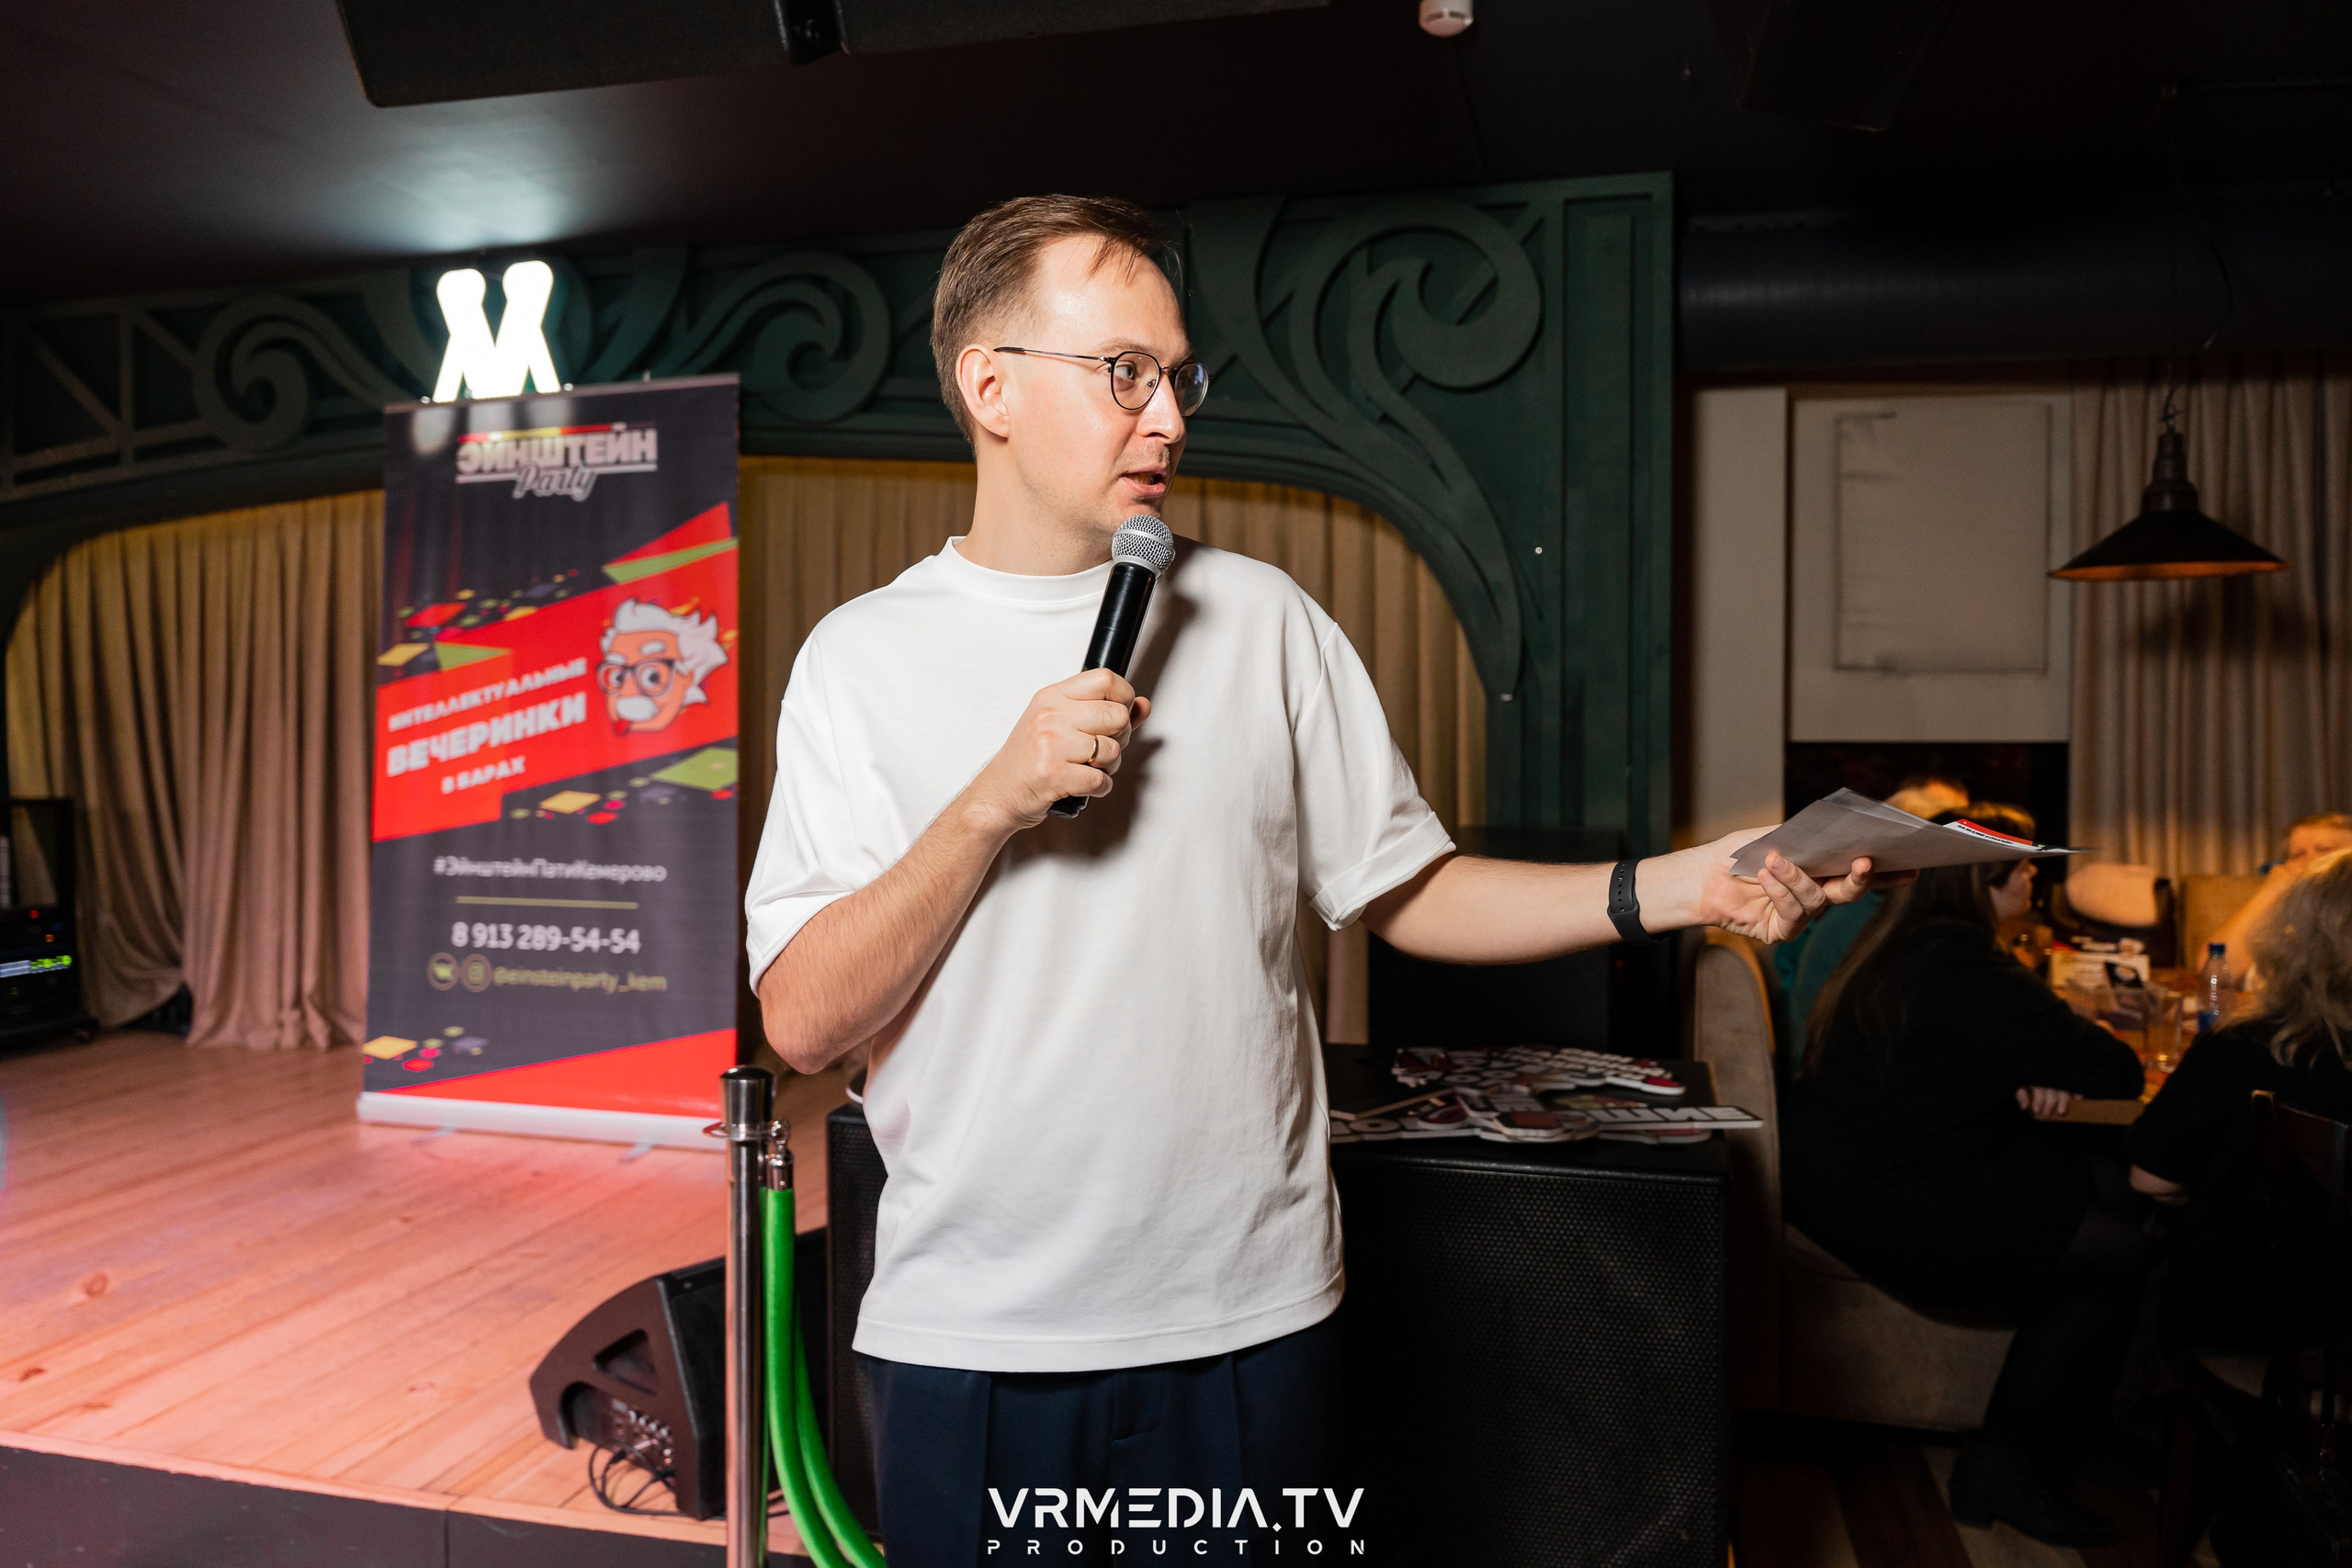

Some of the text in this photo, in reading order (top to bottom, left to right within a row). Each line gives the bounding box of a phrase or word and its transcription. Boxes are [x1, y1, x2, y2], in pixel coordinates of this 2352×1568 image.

[512, 462, 599, 502] Party
[388, 657, 588, 732] ИНТЕЛЛЕКТУАЛЬНЫЕ
[387, 692, 587, 777] ВЕЧЕРИНКИ
[441, 756, 526, 795] В БАРАХ
[451, 921, 640, 954] 8 913 289-54-54
